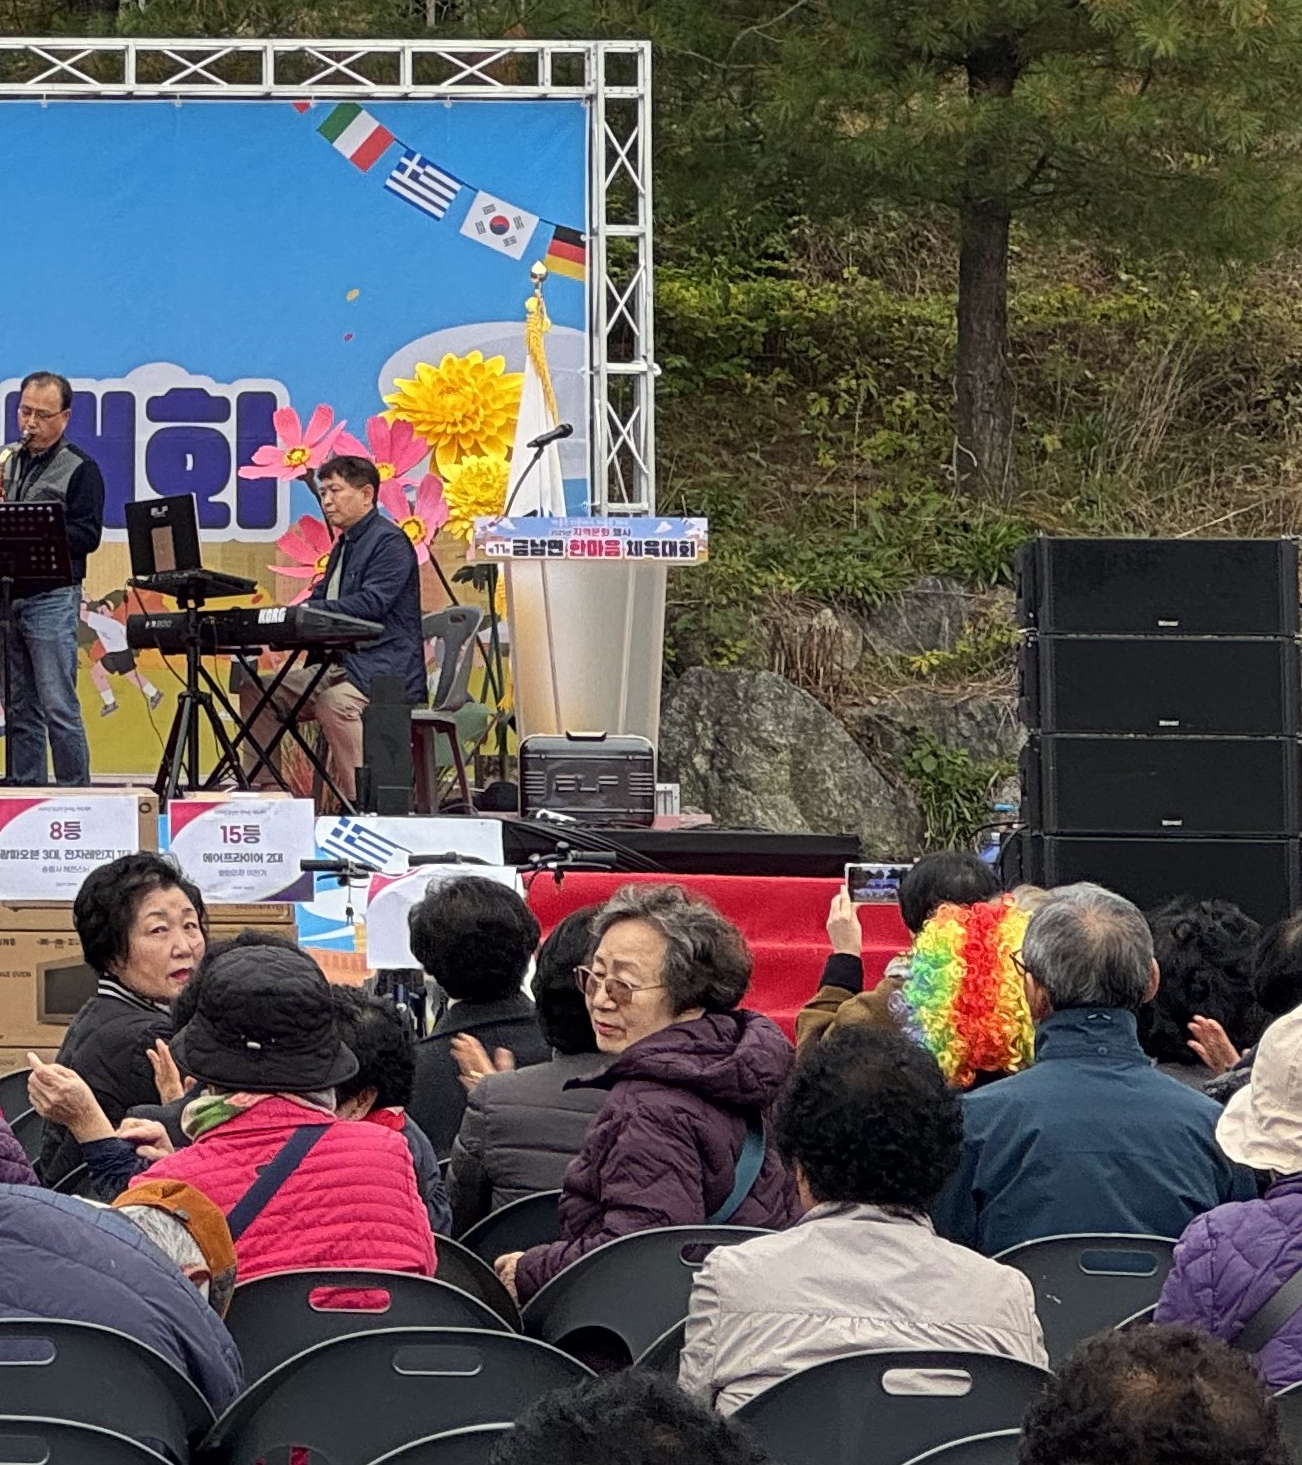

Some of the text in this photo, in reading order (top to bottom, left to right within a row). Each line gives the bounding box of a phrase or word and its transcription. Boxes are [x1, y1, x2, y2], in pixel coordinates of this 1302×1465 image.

[512, 539, 564, 557] 금남면
[570, 539, 621, 557] 한마음
[626, 539, 696, 558] 체육대회
[257, 607, 287, 625] KORG
[49, 820, 82, 841] 8등
[220, 824, 261, 844] 15등
[64, 849, 115, 861] 전자레인지
[202, 852, 284, 864] 에어프라이어 2대
